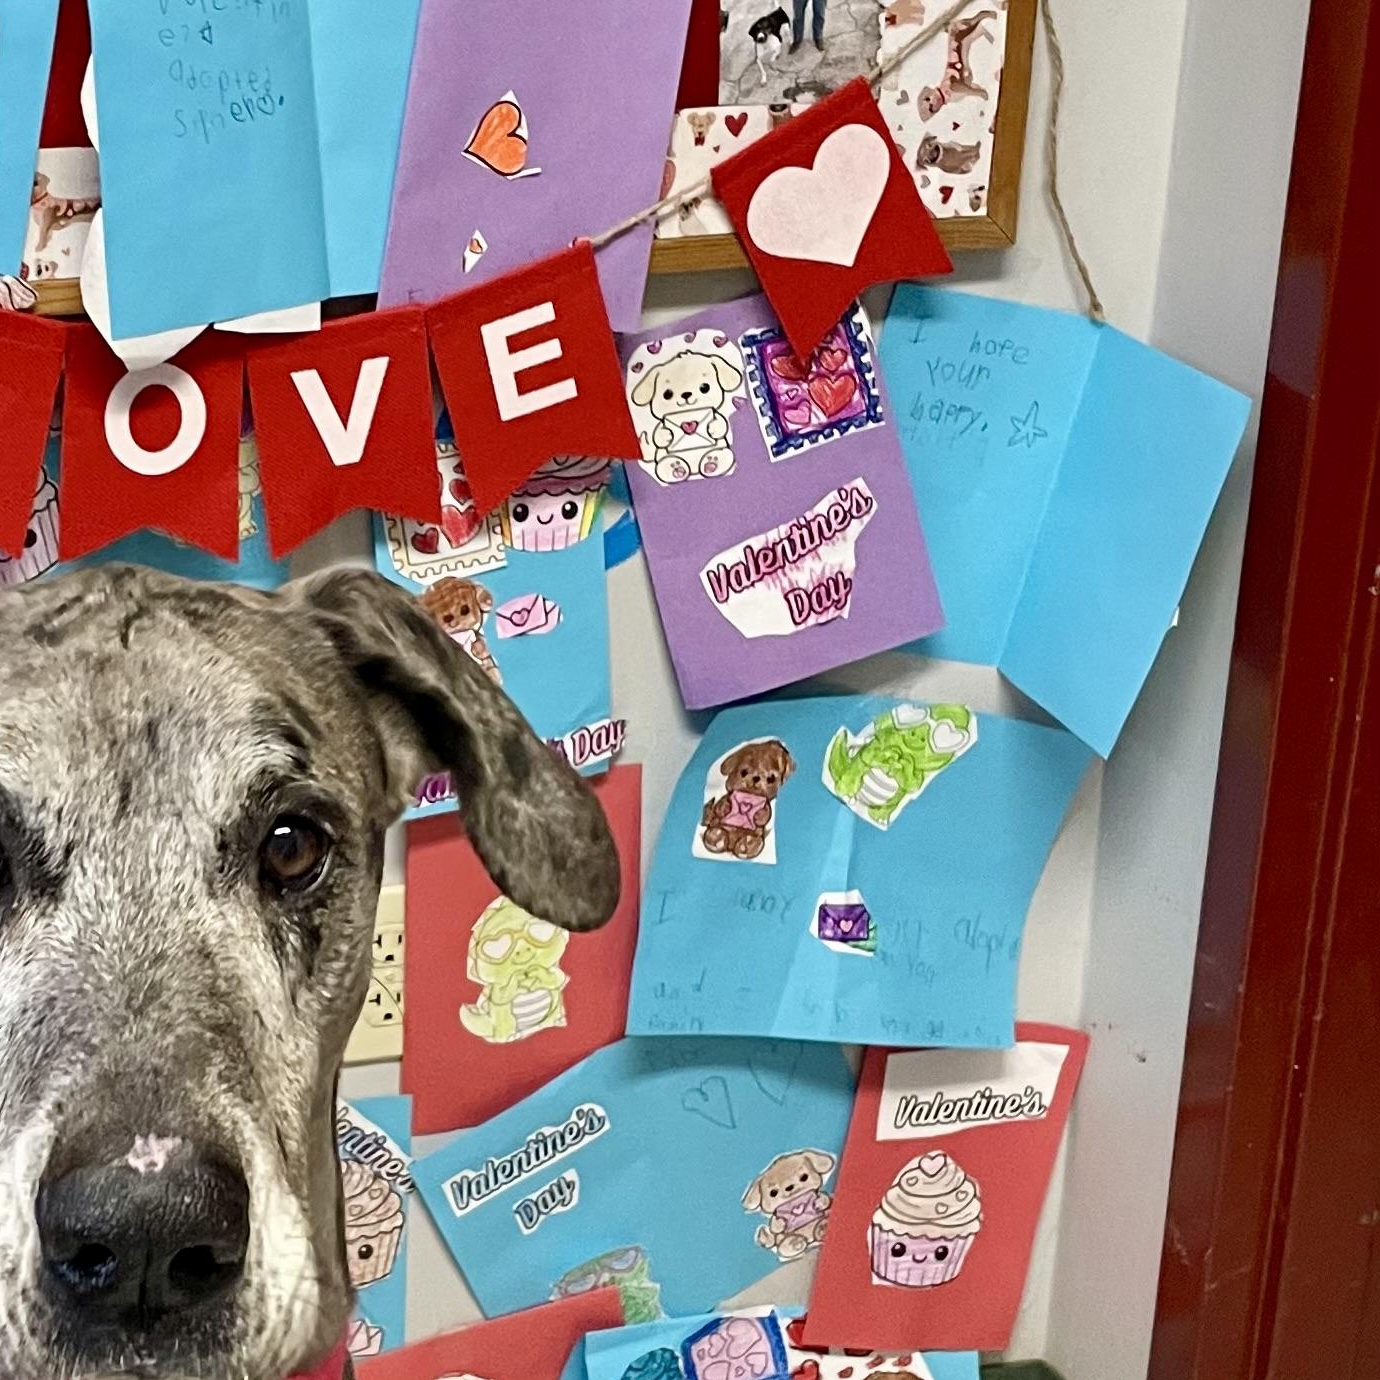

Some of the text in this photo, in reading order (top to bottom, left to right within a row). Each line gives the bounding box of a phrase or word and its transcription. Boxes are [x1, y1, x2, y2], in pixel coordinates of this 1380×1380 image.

[706, 486, 874, 603] Valentine's
[784, 572, 852, 626] Day
[894, 1086, 1048, 1129] Valentine's
[450, 1107, 606, 1211] Valentine's
[515, 1176, 576, 1230] Day
